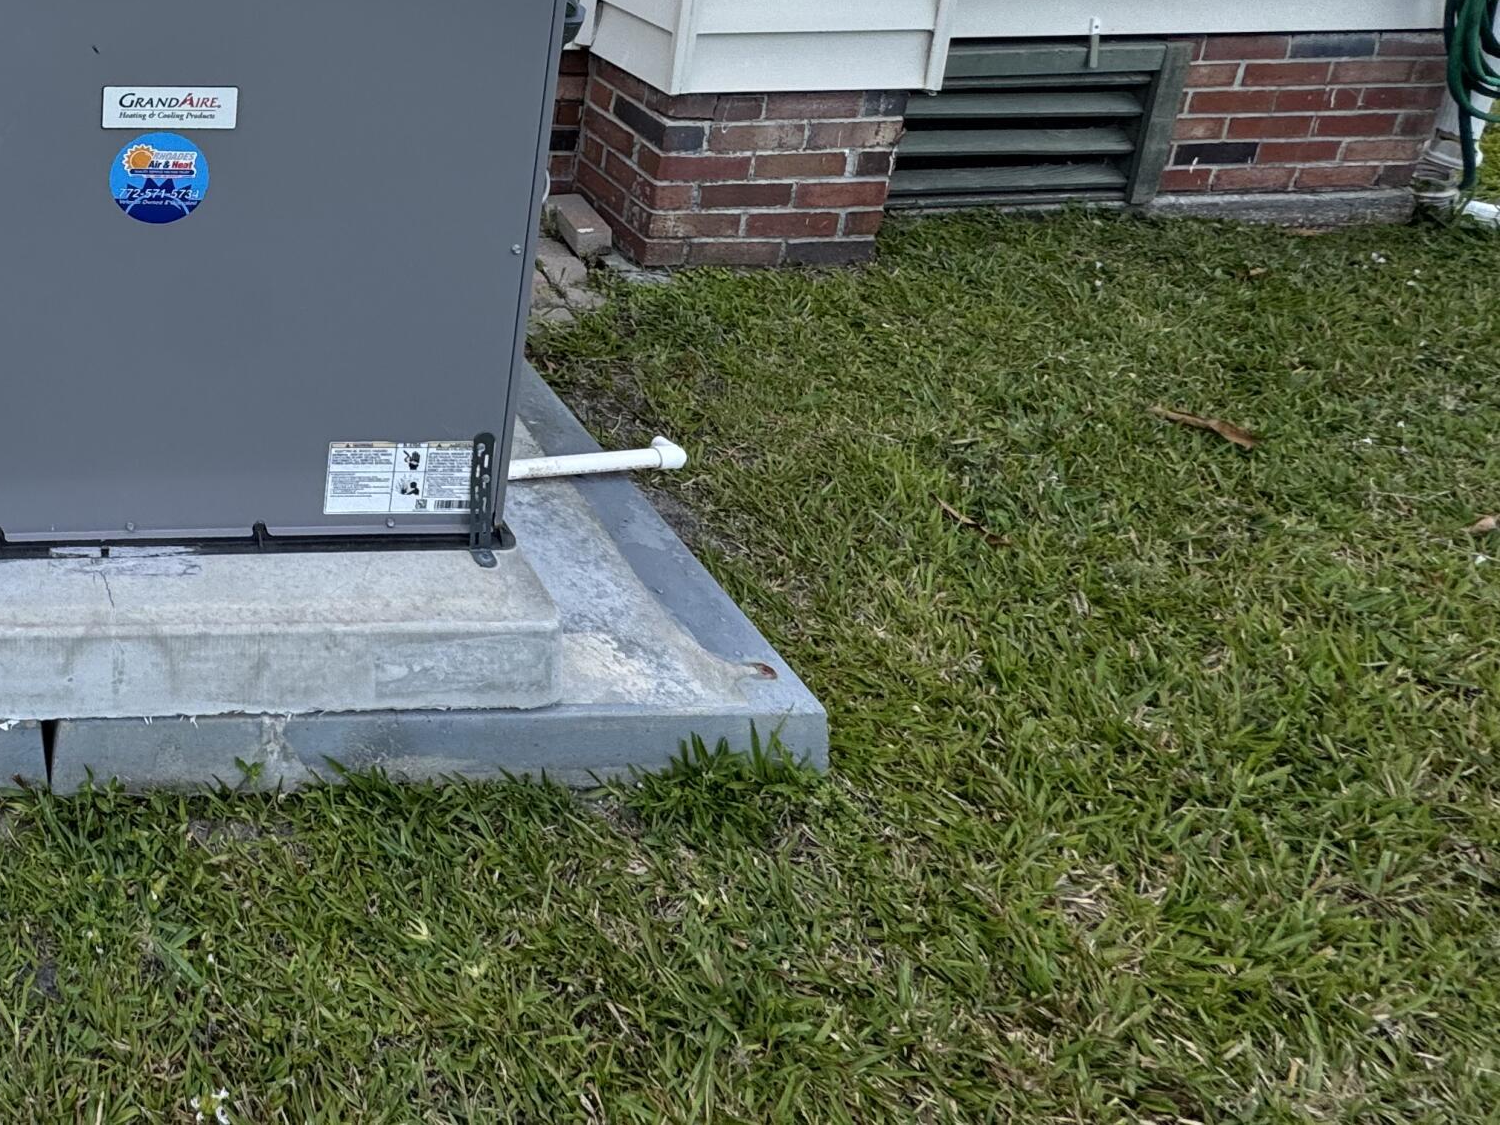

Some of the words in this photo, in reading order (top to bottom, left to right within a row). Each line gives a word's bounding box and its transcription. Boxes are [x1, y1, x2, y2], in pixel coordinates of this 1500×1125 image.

[119, 112, 146, 121] Heating
[158, 112, 184, 121] Cooling
[152, 153, 195, 161] RHOADES
[148, 160, 163, 169] Air
[163, 161, 170, 169] &
[172, 161, 193, 169] Heat
